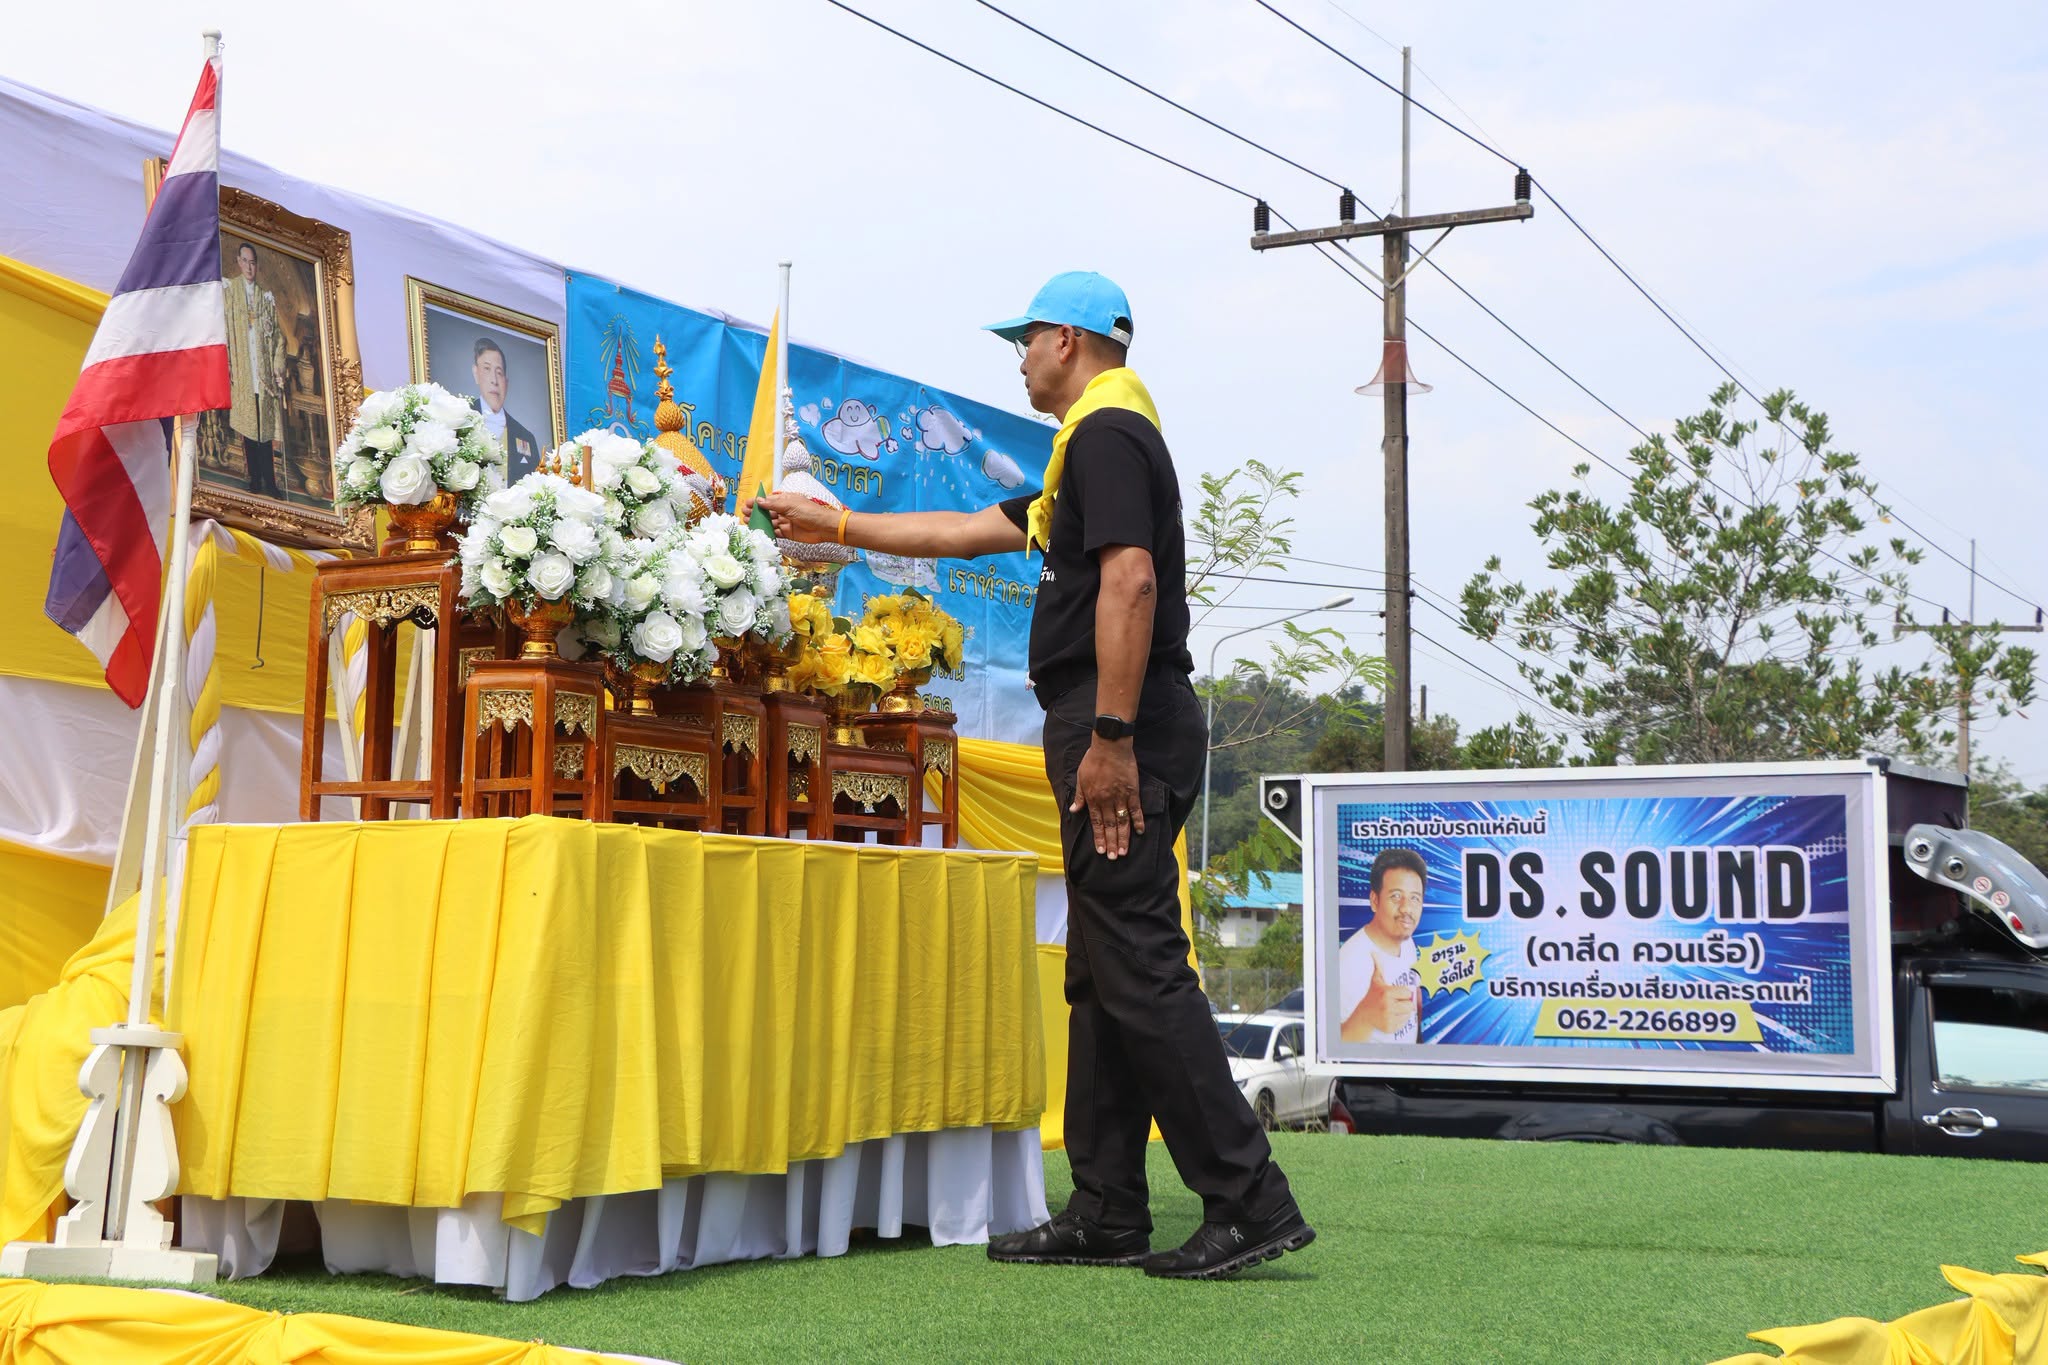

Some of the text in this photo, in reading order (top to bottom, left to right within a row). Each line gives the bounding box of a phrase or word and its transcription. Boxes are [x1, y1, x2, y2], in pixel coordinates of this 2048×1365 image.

[948, 563, 1039, 608] เราทำคว
[1354, 810, 1546, 837] เรารักคนขับรถแห่คันนี้
[1465, 850, 1807, 920] DS.SOUND
[1633, 932, 1761, 970] ควนเรือ)
[1439, 959, 1475, 985] จัดให้
[1490, 971, 1810, 1003] บริการเครื่องเสียงและรถแห่
[1557, 1009, 1737, 1033] 062-2266899
